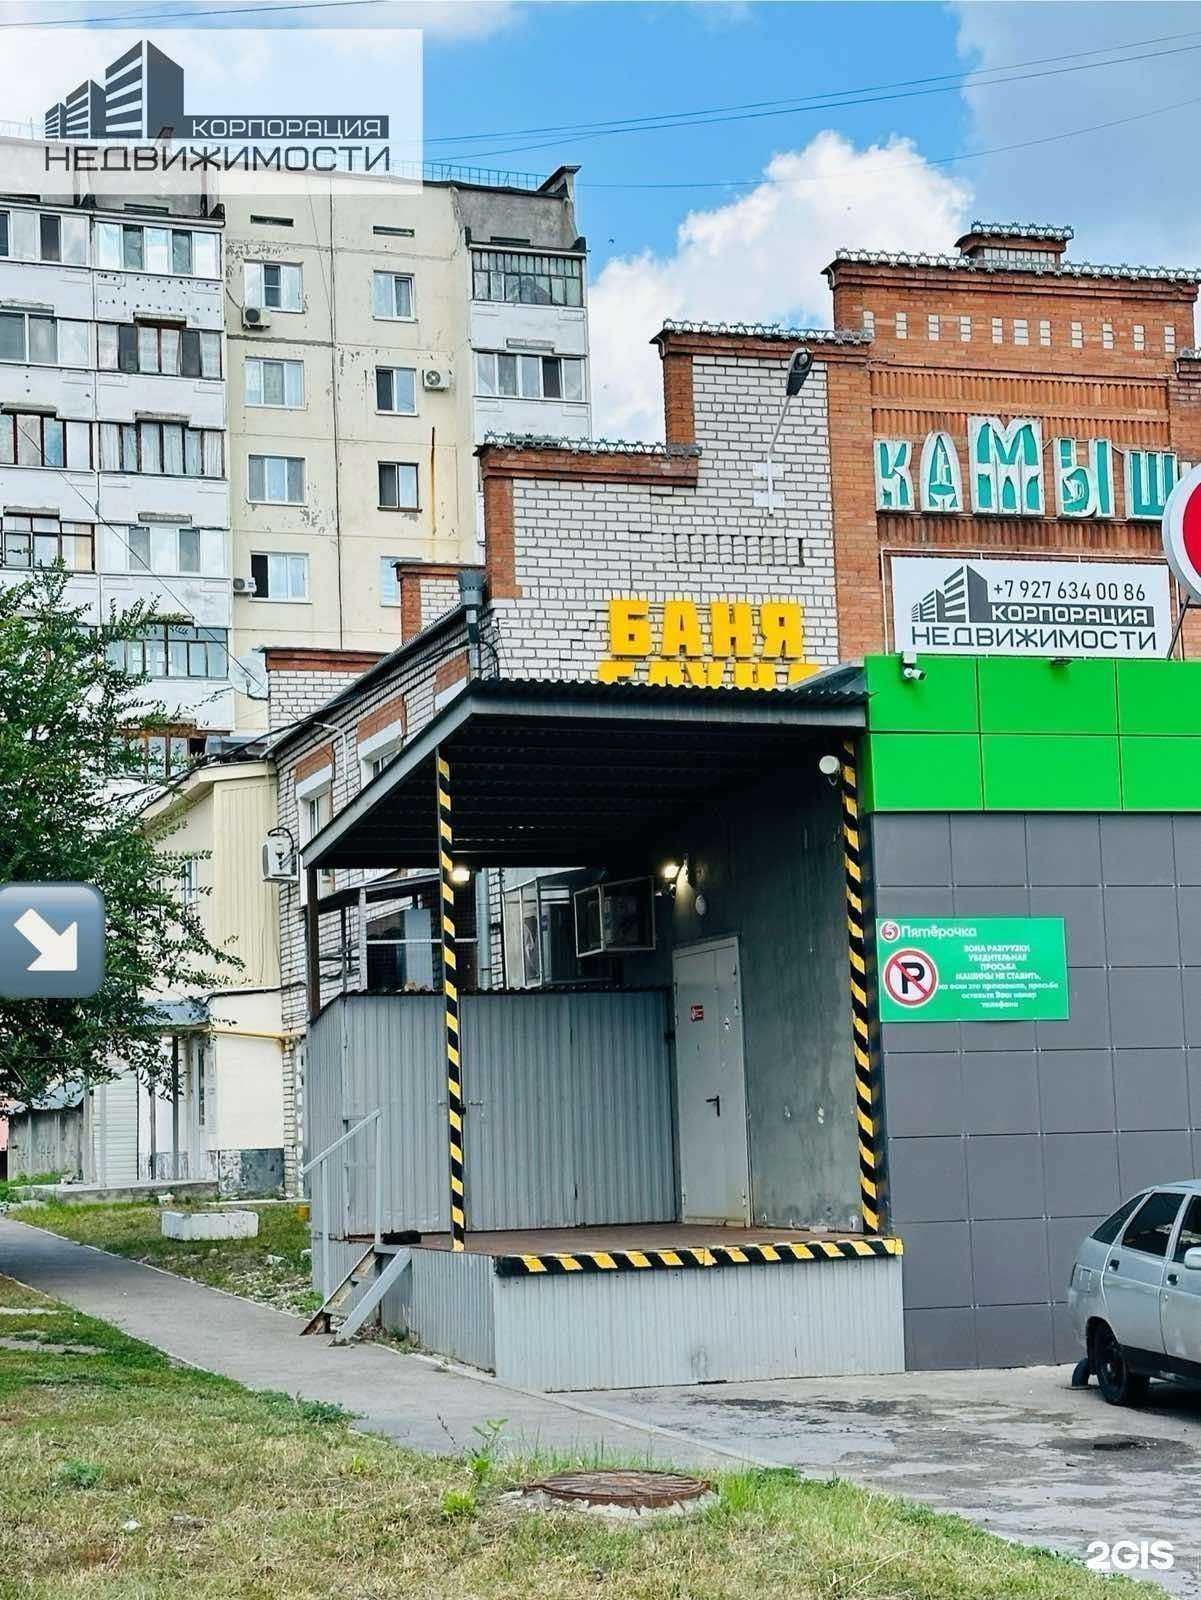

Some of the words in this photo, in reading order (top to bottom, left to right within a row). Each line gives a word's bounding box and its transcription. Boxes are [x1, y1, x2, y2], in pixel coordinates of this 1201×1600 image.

[993, 580, 1013, 598] +7
[1019, 580, 1051, 599] 927
[1057, 581, 1091, 600] 634
[1096, 582, 1118, 600] 00
[1123, 583, 1145, 601] 86
[991, 605, 1148, 626] КОРПОРАЦИЯ
[608, 599, 803, 659] БАНЯ
[912, 626, 1157, 650] НЕДВИЖИМОСТИ
